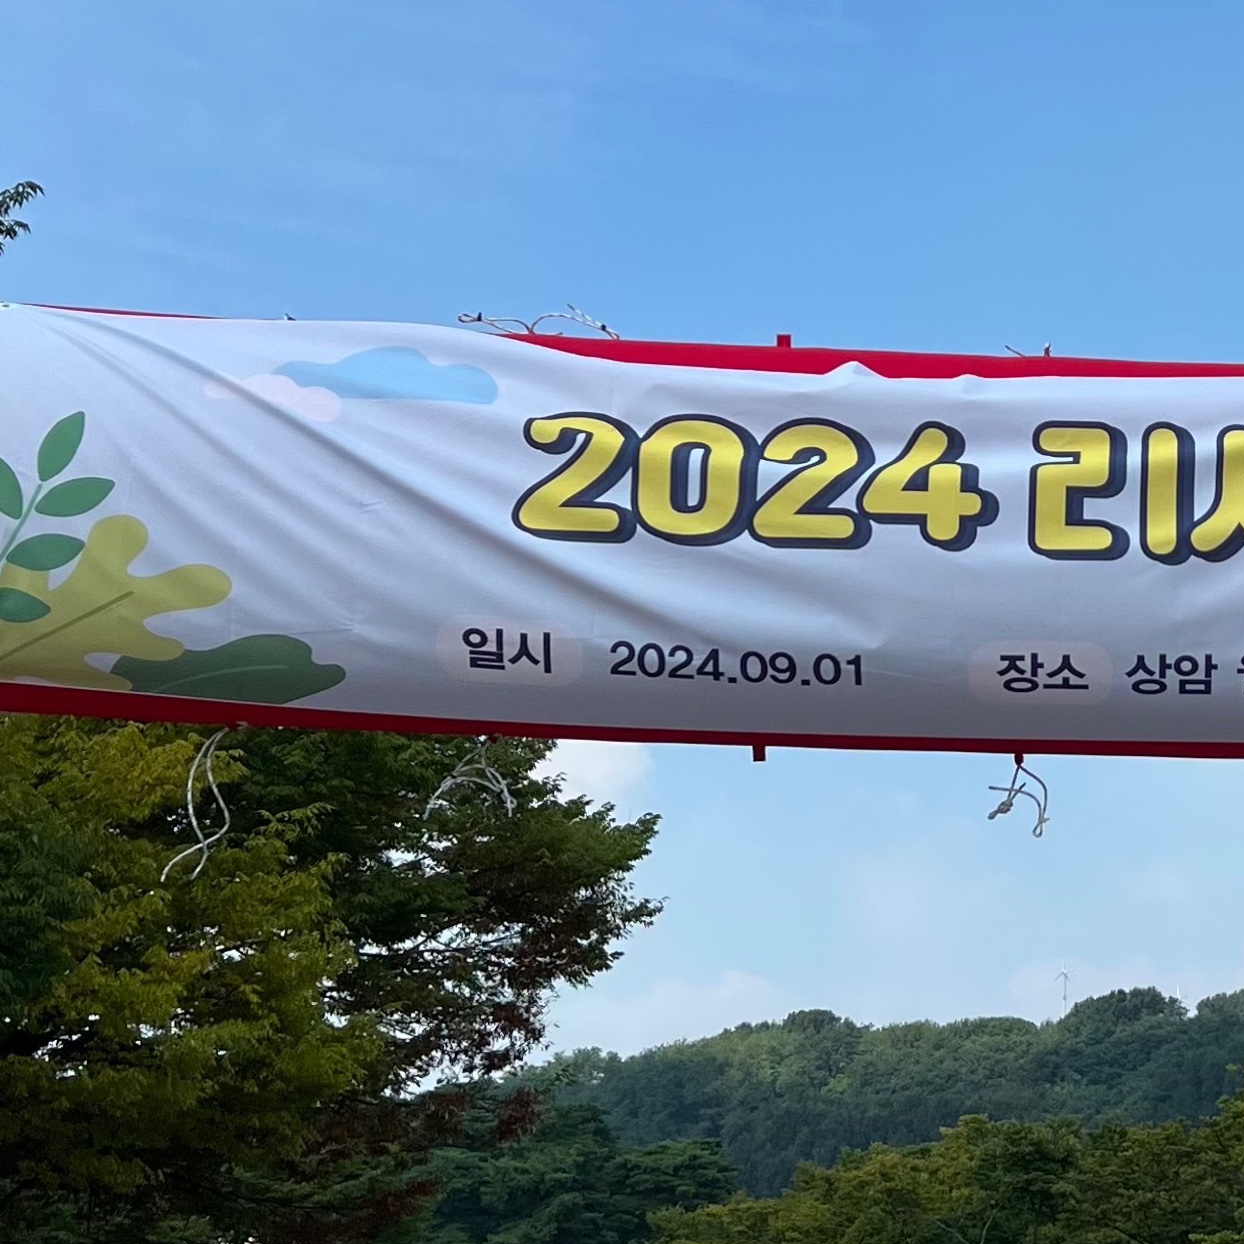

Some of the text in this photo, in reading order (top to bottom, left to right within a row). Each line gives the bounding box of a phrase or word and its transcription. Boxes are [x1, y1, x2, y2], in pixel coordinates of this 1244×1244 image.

[512, 412, 999, 551] 2024
[463, 628, 862, 686] 일시 2024.09.01
[997, 653, 1089, 692] 장소
[1125, 654, 1218, 694] 상암
